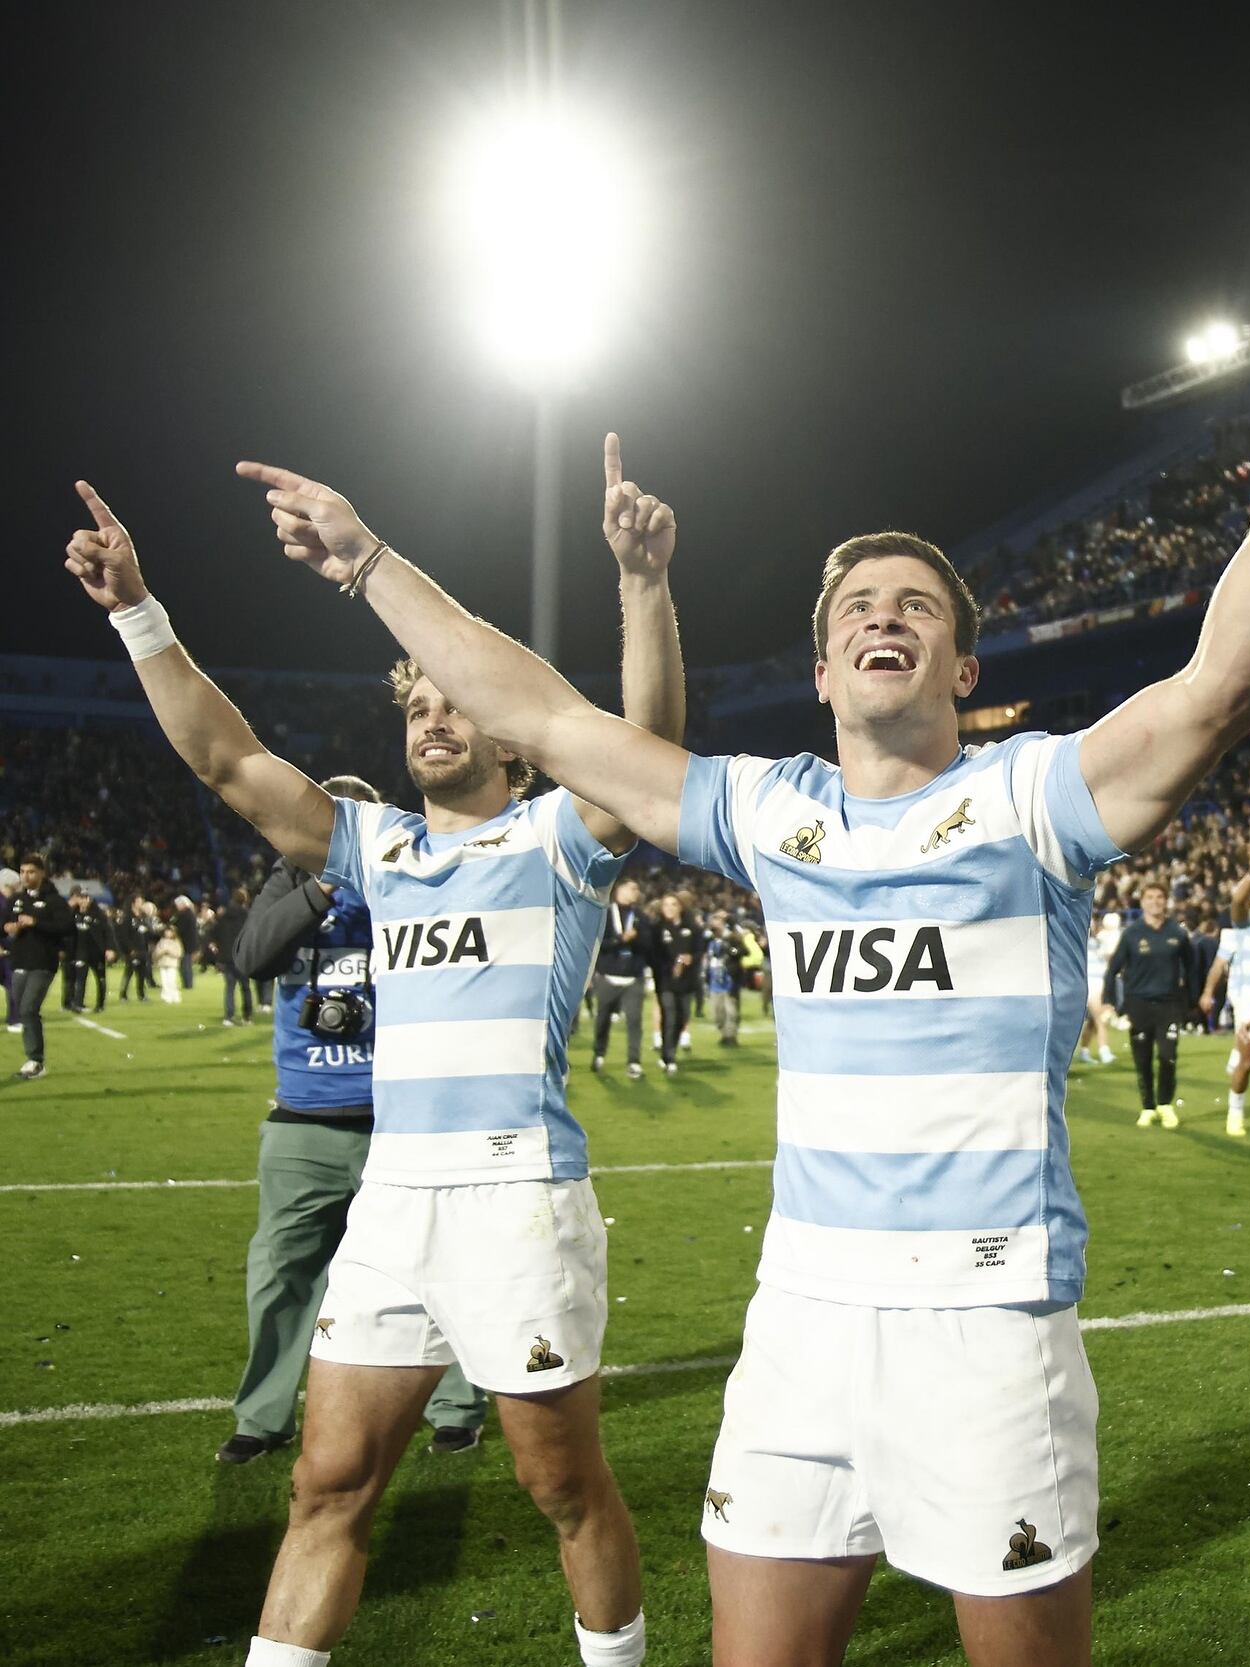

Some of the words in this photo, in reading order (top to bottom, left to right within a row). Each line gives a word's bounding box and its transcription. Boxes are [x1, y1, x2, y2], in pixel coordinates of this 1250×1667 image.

[382, 917, 489, 970] VISA
[787, 926, 954, 993] VISA
[972, 1236, 1009, 1244] BAUTISTA
[975, 1244, 1006, 1252] DELGUY
[985, 1259, 1006, 1267] CAPS
